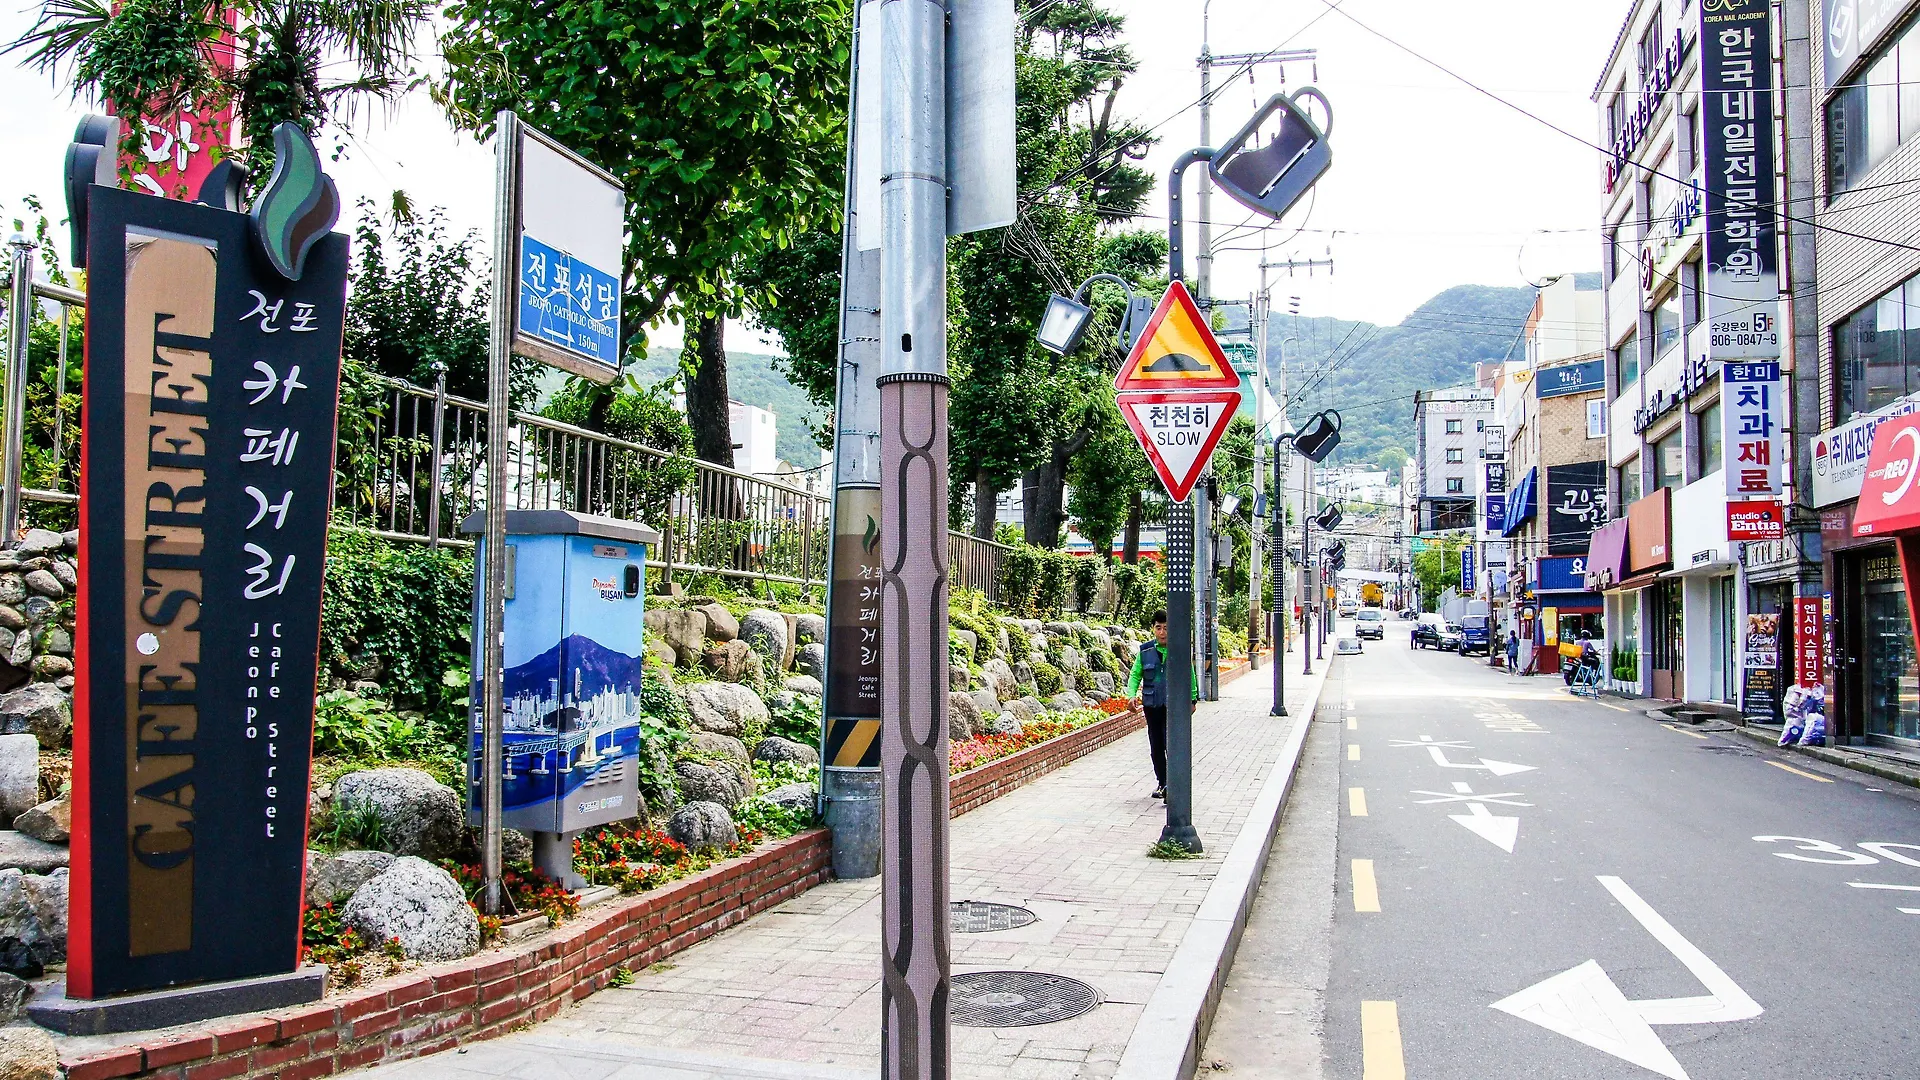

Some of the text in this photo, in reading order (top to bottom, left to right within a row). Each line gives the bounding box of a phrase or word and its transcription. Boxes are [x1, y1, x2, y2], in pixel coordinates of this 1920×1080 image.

[1737, 12, 1766, 20] ACADEMY
[1719, 27, 1762, 282] 한국네일전문학원
[527, 251, 616, 320] 전포성당
[240, 289, 322, 334] 전포
[553, 304, 587, 327] CATHOLIC
[587, 318, 614, 338] CHURCH
[1711, 321, 1749, 332] 수강문의
[1711, 333, 1777, 346] 806-0847~9
[1732, 364, 1771, 381] 한미
[1149, 405, 1209, 428] 천천히
[1157, 431, 1201, 446] SLOW
[1737, 384, 1774, 492] 치과재료
[240, 359, 309, 600] 카페거리
[1883, 458, 1909, 480] REO
[1730, 512, 1760, 521] studio
[1731, 520, 1781, 531] Entia
[132, 312, 218, 872] CAFE STREET
[592, 577, 616, 593] Dynamic
[600, 589, 623, 600] BUSAN
[859, 585, 880, 666] 카페거리
[1803, 604, 1818, 681] 엔시아 스튜디오
[246, 621, 260, 740] Jeonpo
[861, 683, 875, 691] Cafe
[858, 691, 877, 699] Street
[266, 621, 282, 840] Cafe Street
